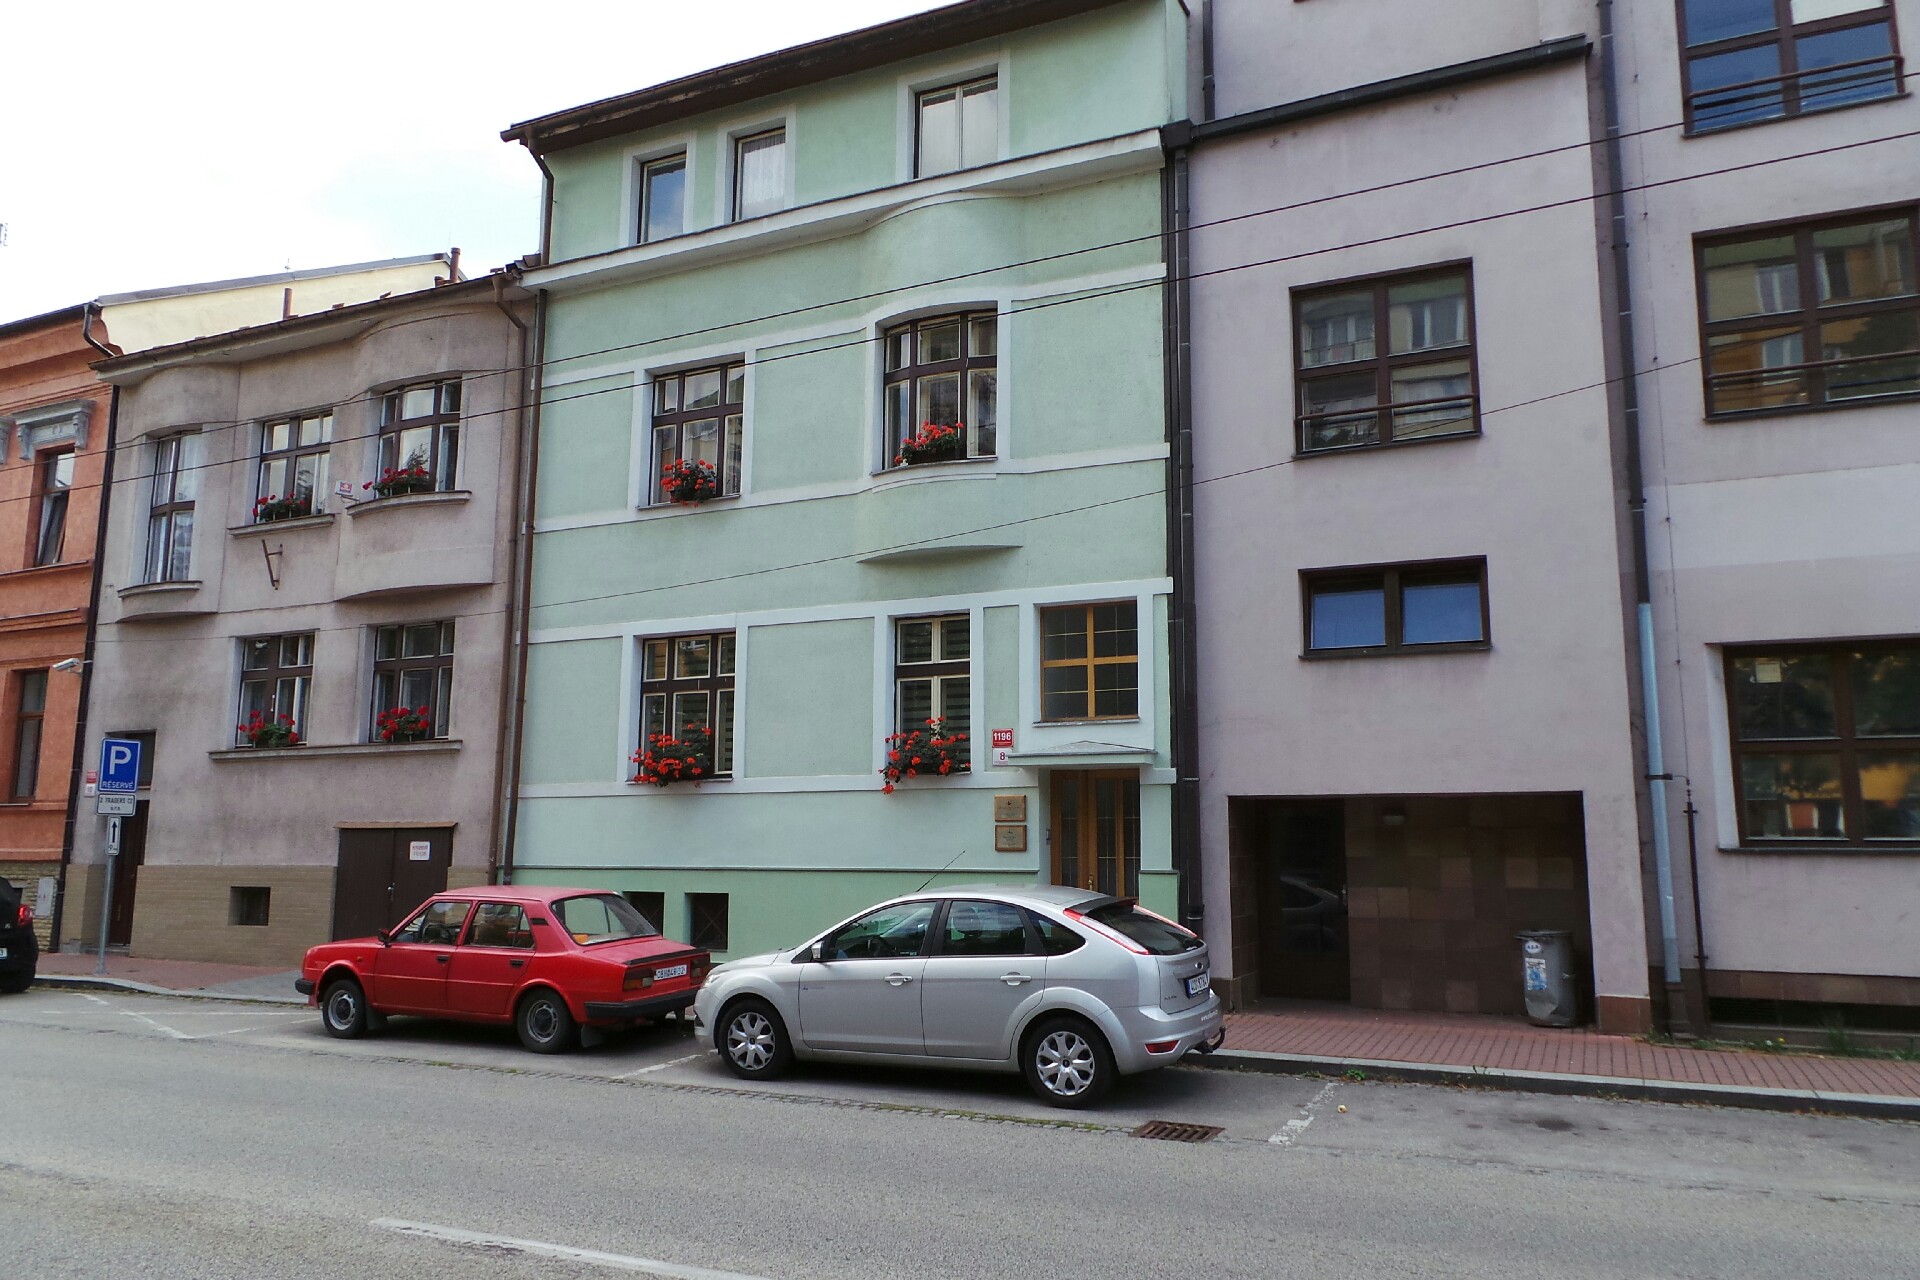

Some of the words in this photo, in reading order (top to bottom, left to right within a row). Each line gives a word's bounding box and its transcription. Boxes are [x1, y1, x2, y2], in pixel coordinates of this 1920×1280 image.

[993, 732, 1012, 741] 1196
[109, 745, 132, 775] P
[999, 751, 1006, 761] 8
[102, 780, 134, 789] RÉSERVÉ
